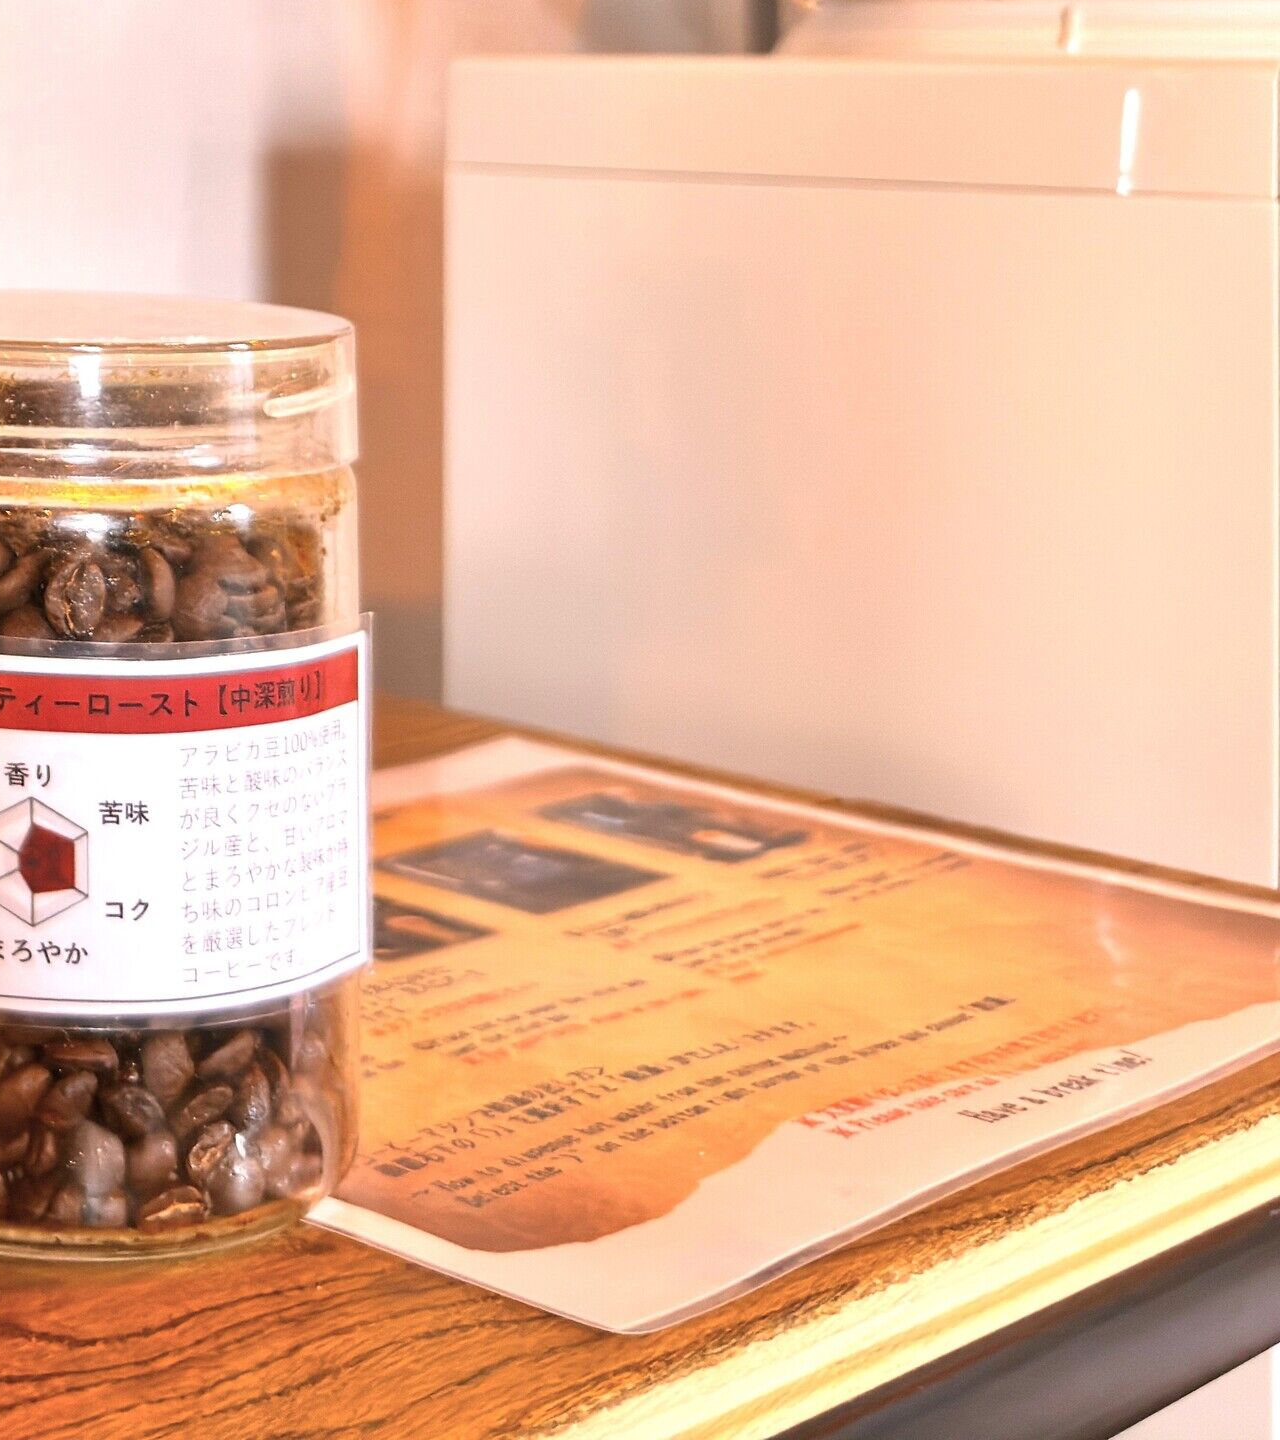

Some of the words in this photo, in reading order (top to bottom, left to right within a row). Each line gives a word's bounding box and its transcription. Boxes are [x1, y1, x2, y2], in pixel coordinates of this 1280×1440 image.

[3, 761, 52, 788] 香り
[98, 799, 150, 825] 苦味
[104, 899, 151, 921] コク
[957, 1102, 1028, 1125] Have
